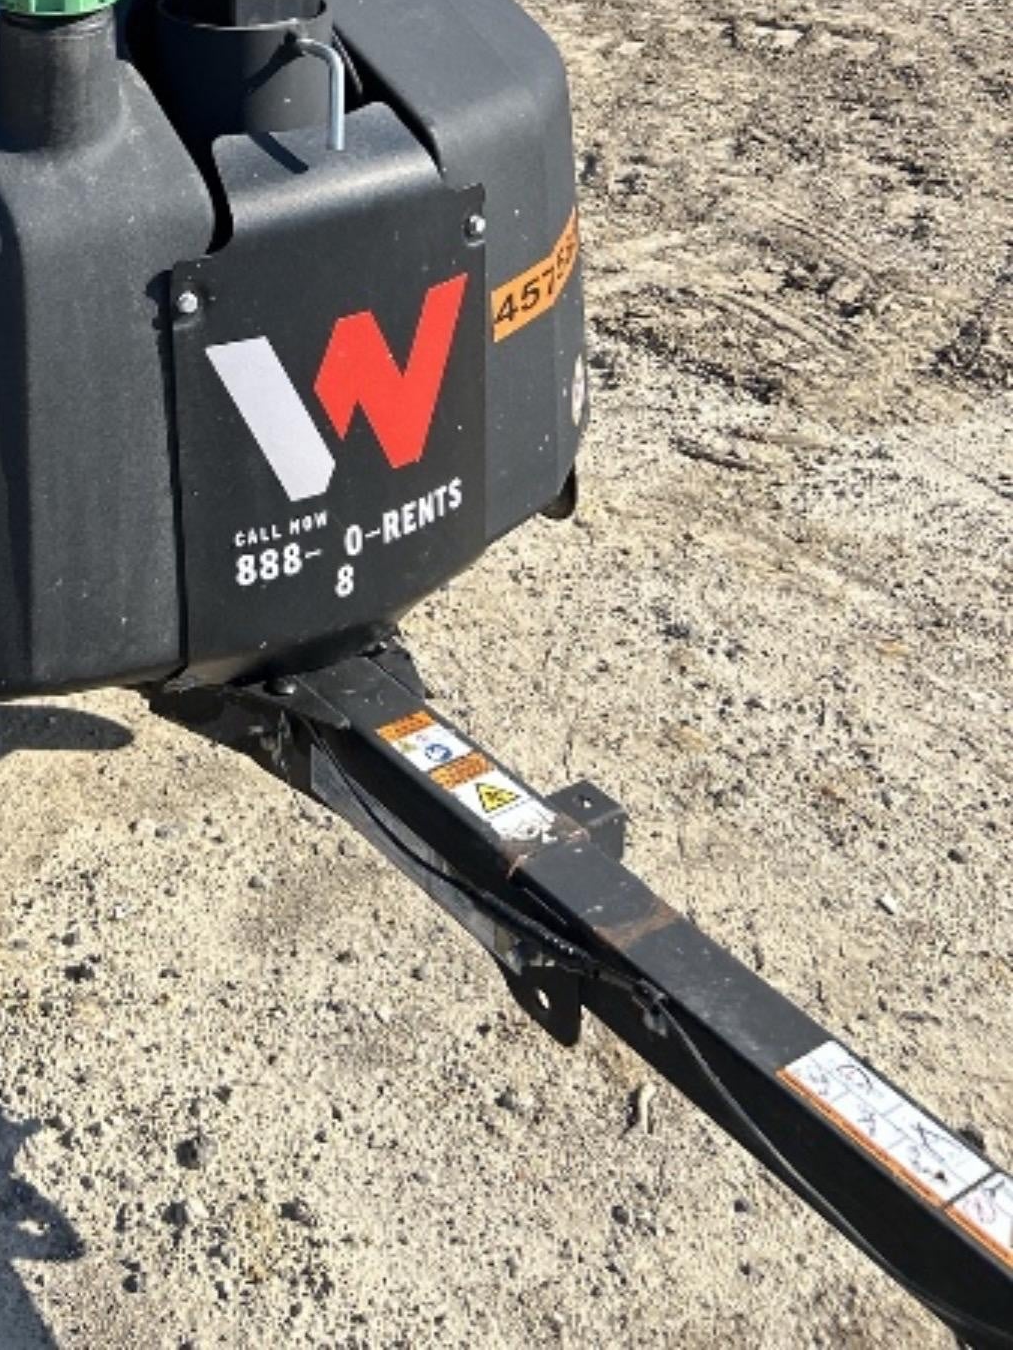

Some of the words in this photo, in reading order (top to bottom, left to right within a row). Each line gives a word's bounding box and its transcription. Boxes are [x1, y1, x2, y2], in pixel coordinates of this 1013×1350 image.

[234, 524, 283, 548] CALL
[289, 509, 329, 535] NOW
[235, 542, 322, 586] 888-
[334, 563, 355, 598] 8
